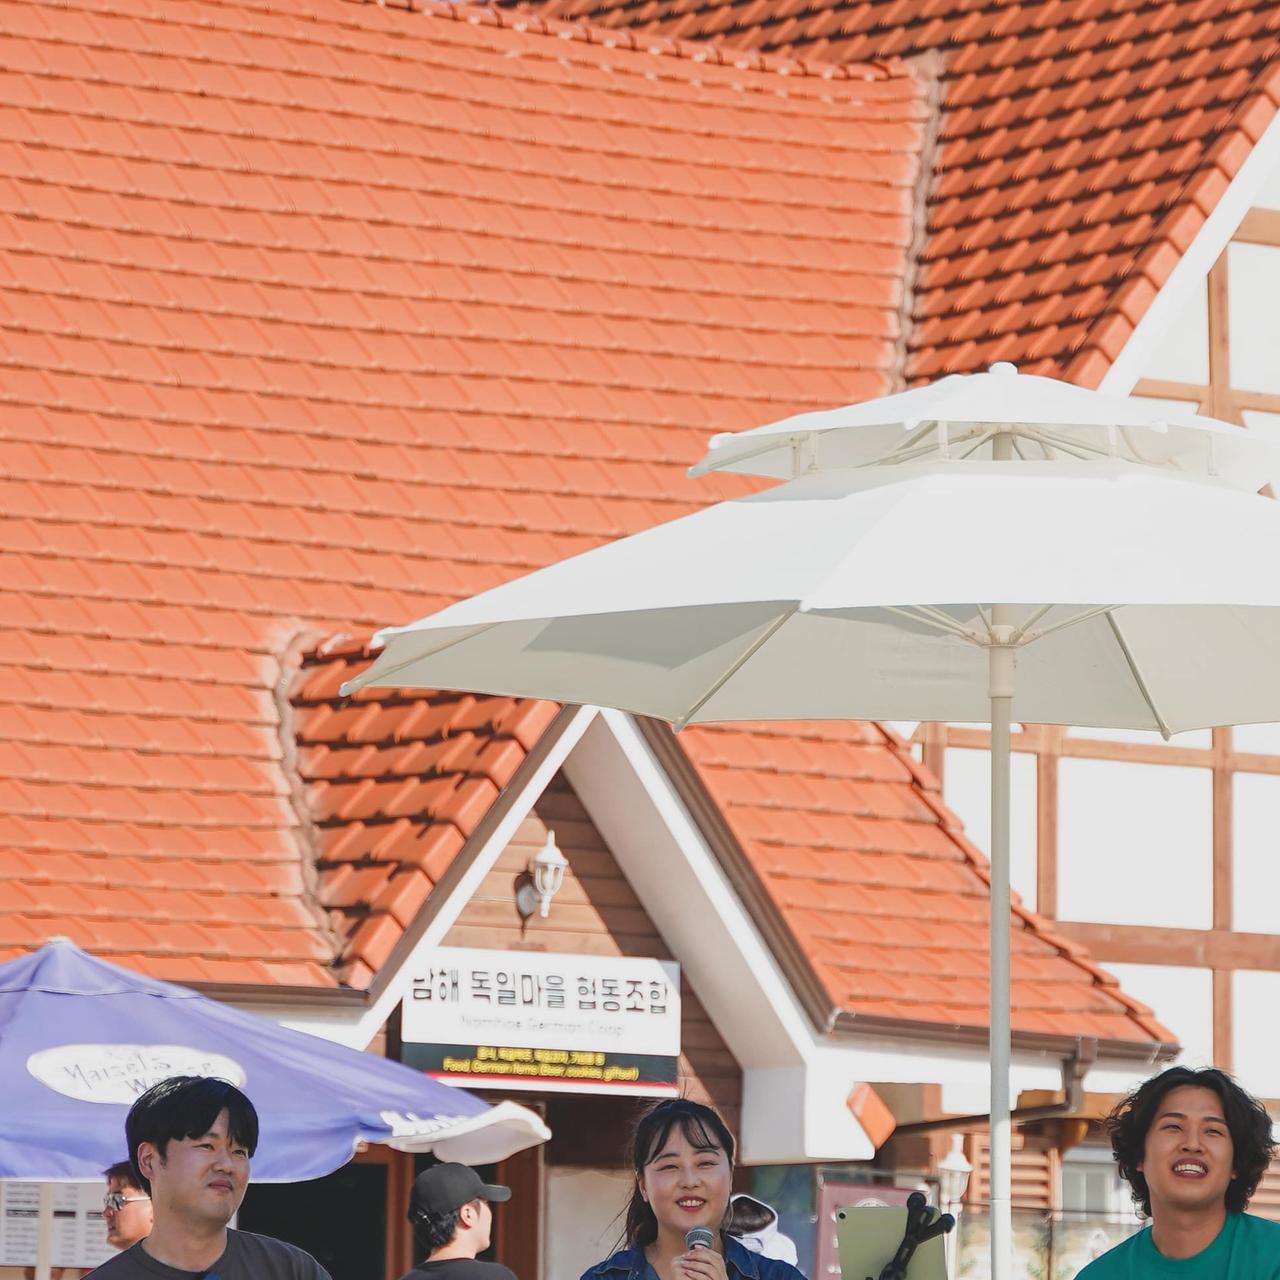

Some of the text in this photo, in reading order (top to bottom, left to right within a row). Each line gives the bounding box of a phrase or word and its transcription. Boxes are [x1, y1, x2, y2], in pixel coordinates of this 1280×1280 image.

[413, 968, 668, 1015] 남해 독일마을 협동조합
